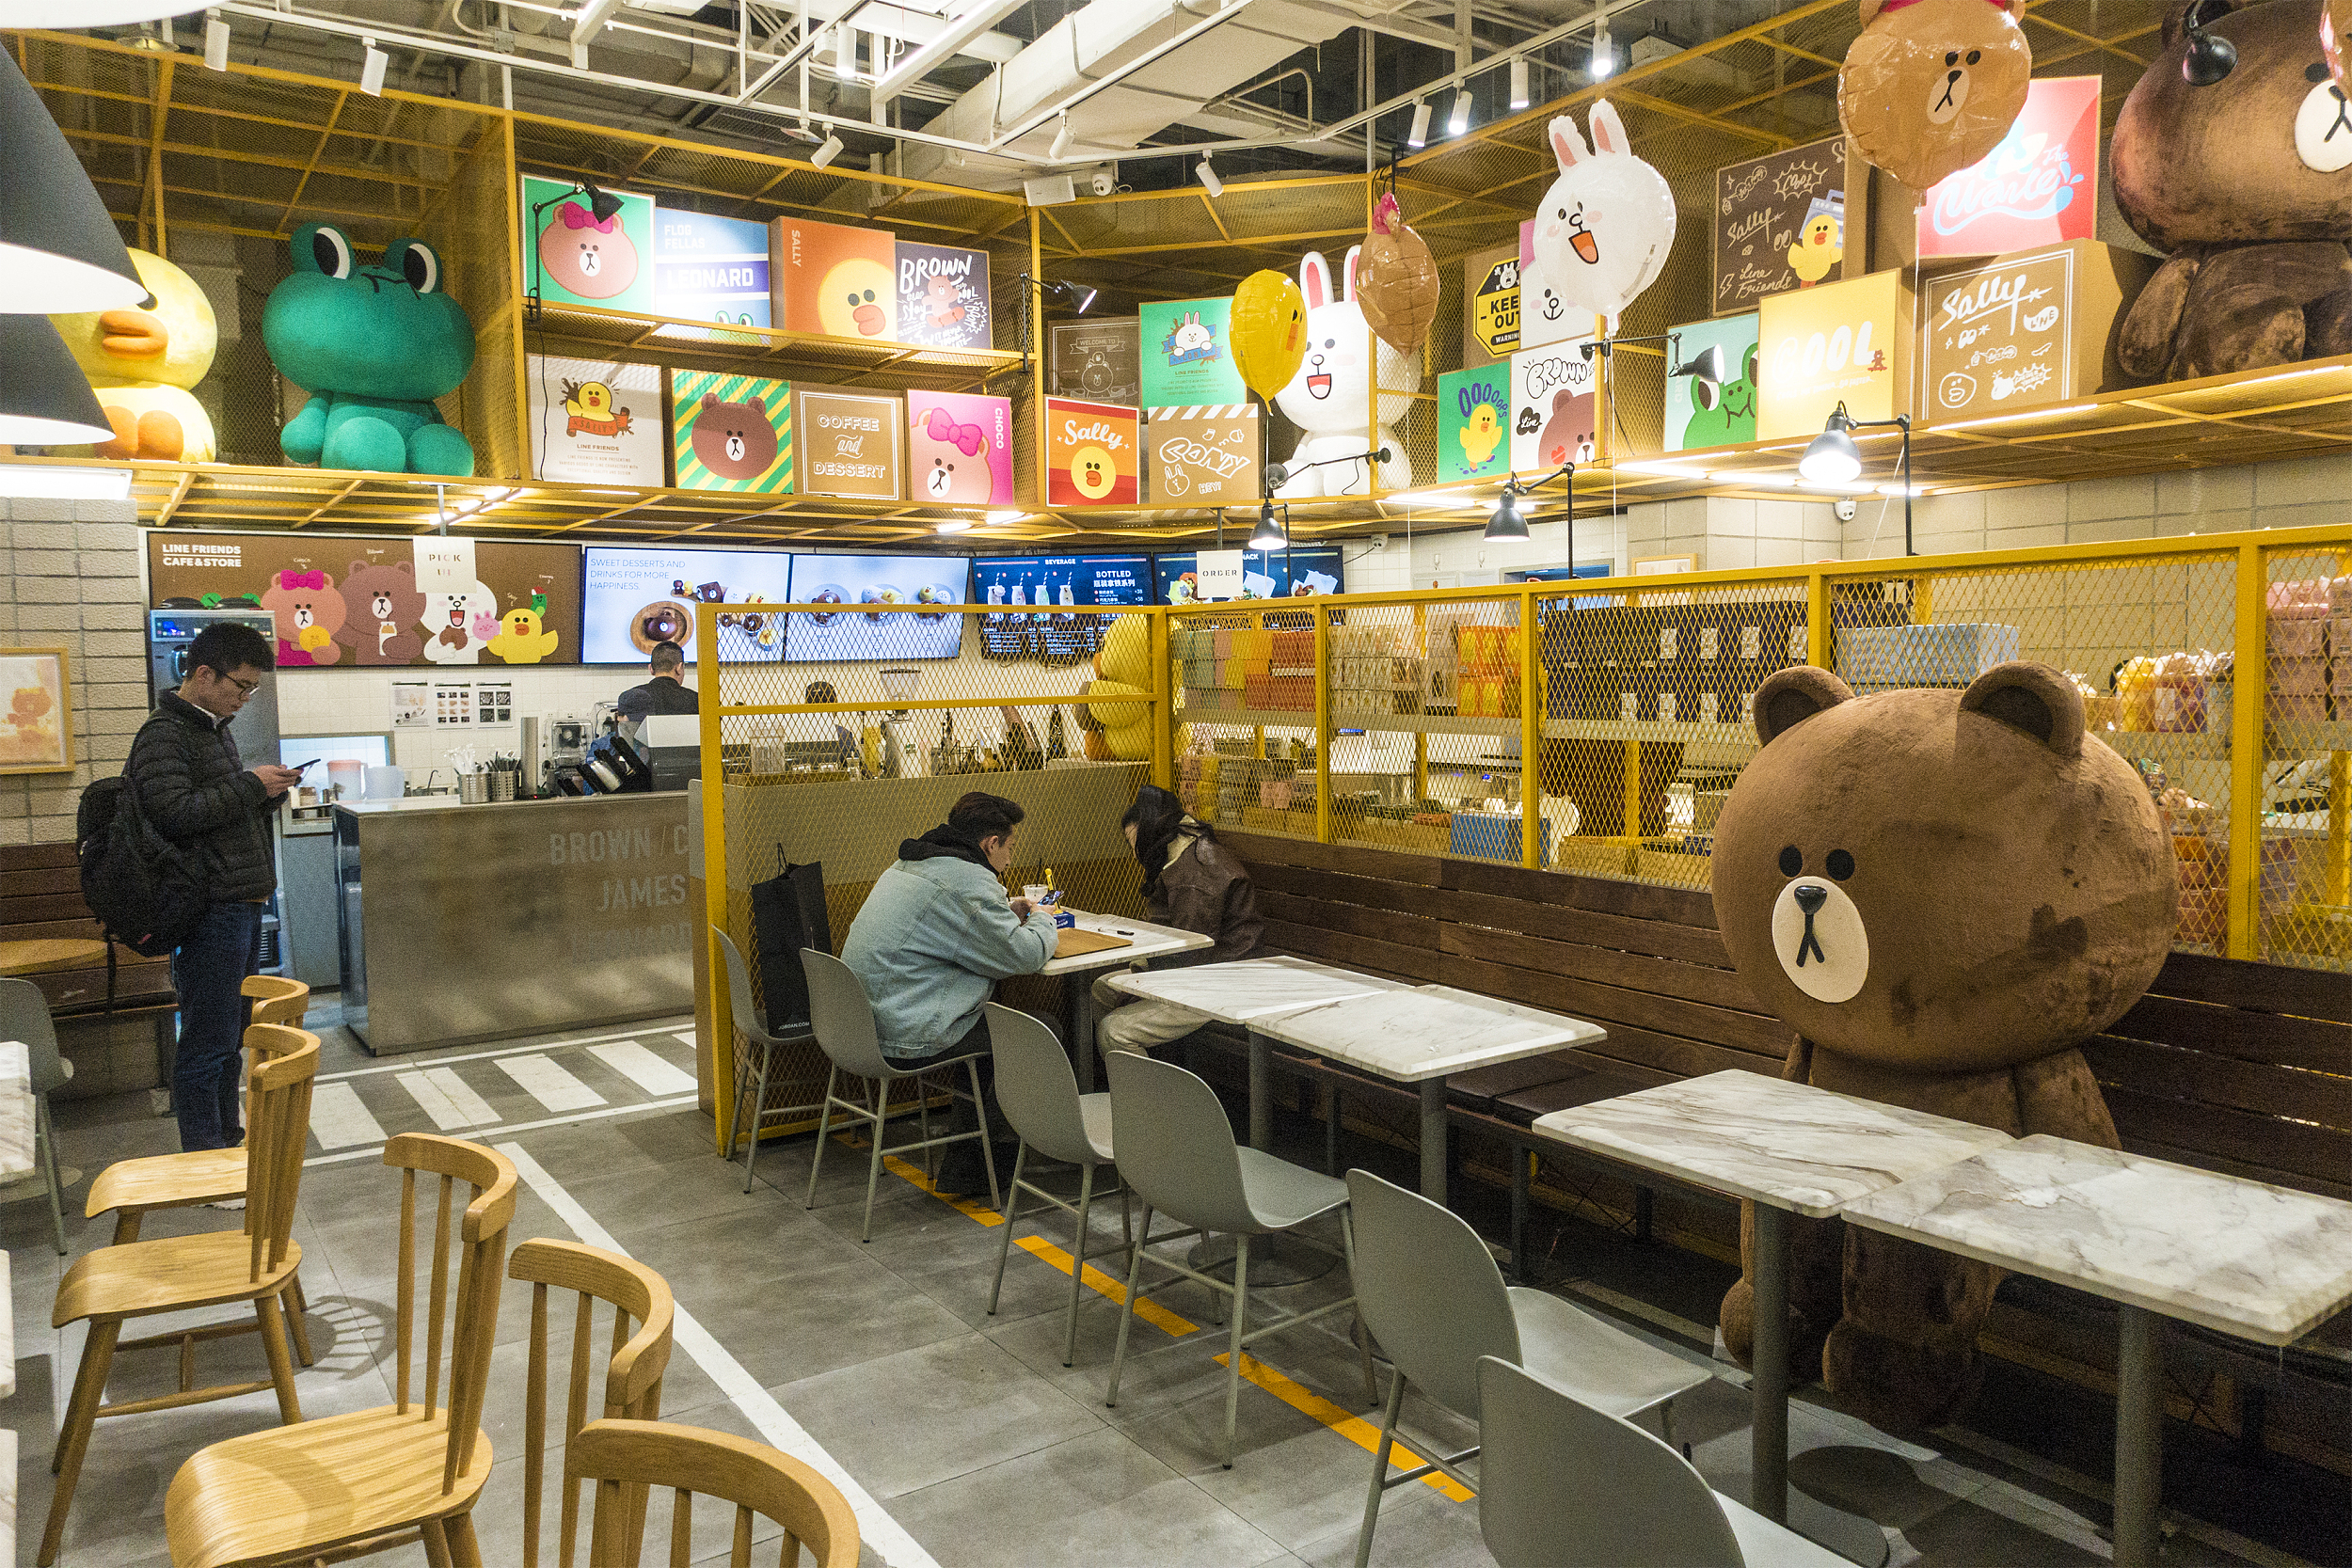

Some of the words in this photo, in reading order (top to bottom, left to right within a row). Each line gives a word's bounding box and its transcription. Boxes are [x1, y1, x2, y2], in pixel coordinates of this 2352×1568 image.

[1727, 207, 1772, 249] Sally
[664, 238, 705, 249] FELLAS
[792, 230, 802, 267] SALLY
[667, 268, 754, 290] LEONARD
[899, 255, 973, 294] BROWN
[1736, 270, 1792, 299] Friends
[1491, 294, 1519, 314] KEE
[1938, 275, 2026, 336] Sally
[1772, 320, 1875, 384] COOL
[1526, 357, 1587, 399] BROWN
[580, 420, 608, 433] SALLY
[817, 414, 880, 432] COFFEE
[995, 407, 1005, 449] CHOCO
[1064, 420, 1123, 450] Sally
[835, 435, 864, 455] and
[1159, 436, 1251, 479] CONY
[813, 461, 885, 479] DESSERT
[1199, 482, 1221, 495] HEY!
[163, 544, 189, 553] LINE
[192, 545, 242, 554] FRIENDS
[429, 554, 461, 562] PICK
[1096, 570, 1131, 578] BOTTLED
[549, 828, 650, 865] BROWN
[596, 874, 686, 911] JAMES
